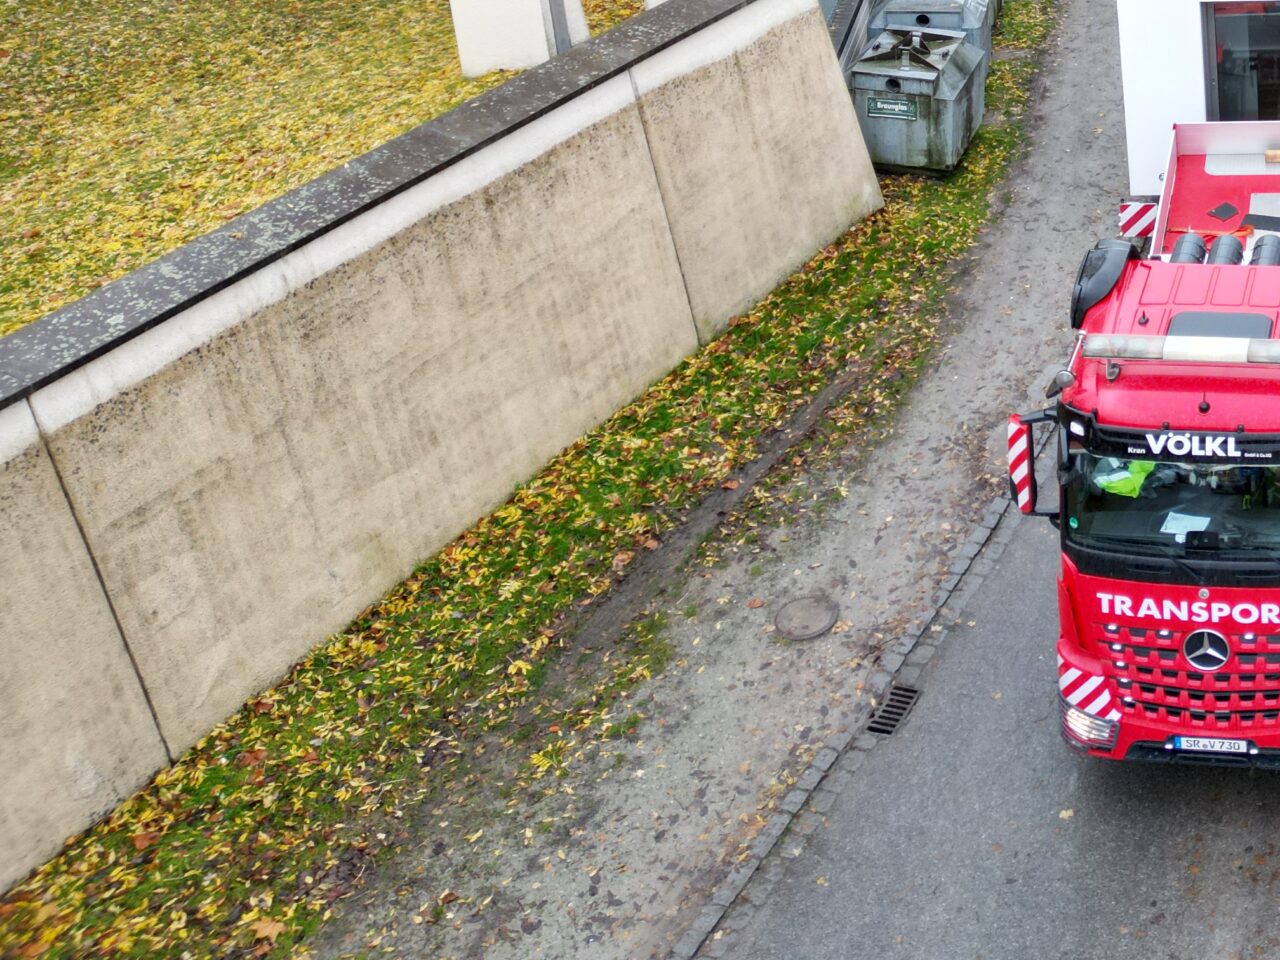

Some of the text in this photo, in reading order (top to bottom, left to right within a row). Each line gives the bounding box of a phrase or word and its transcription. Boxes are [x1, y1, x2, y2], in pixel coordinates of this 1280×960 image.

[1127, 446, 1146, 454] Kran
[1145, 432, 1242, 457] VÖLKL
[1185, 739, 1240, 750] SR V 730
